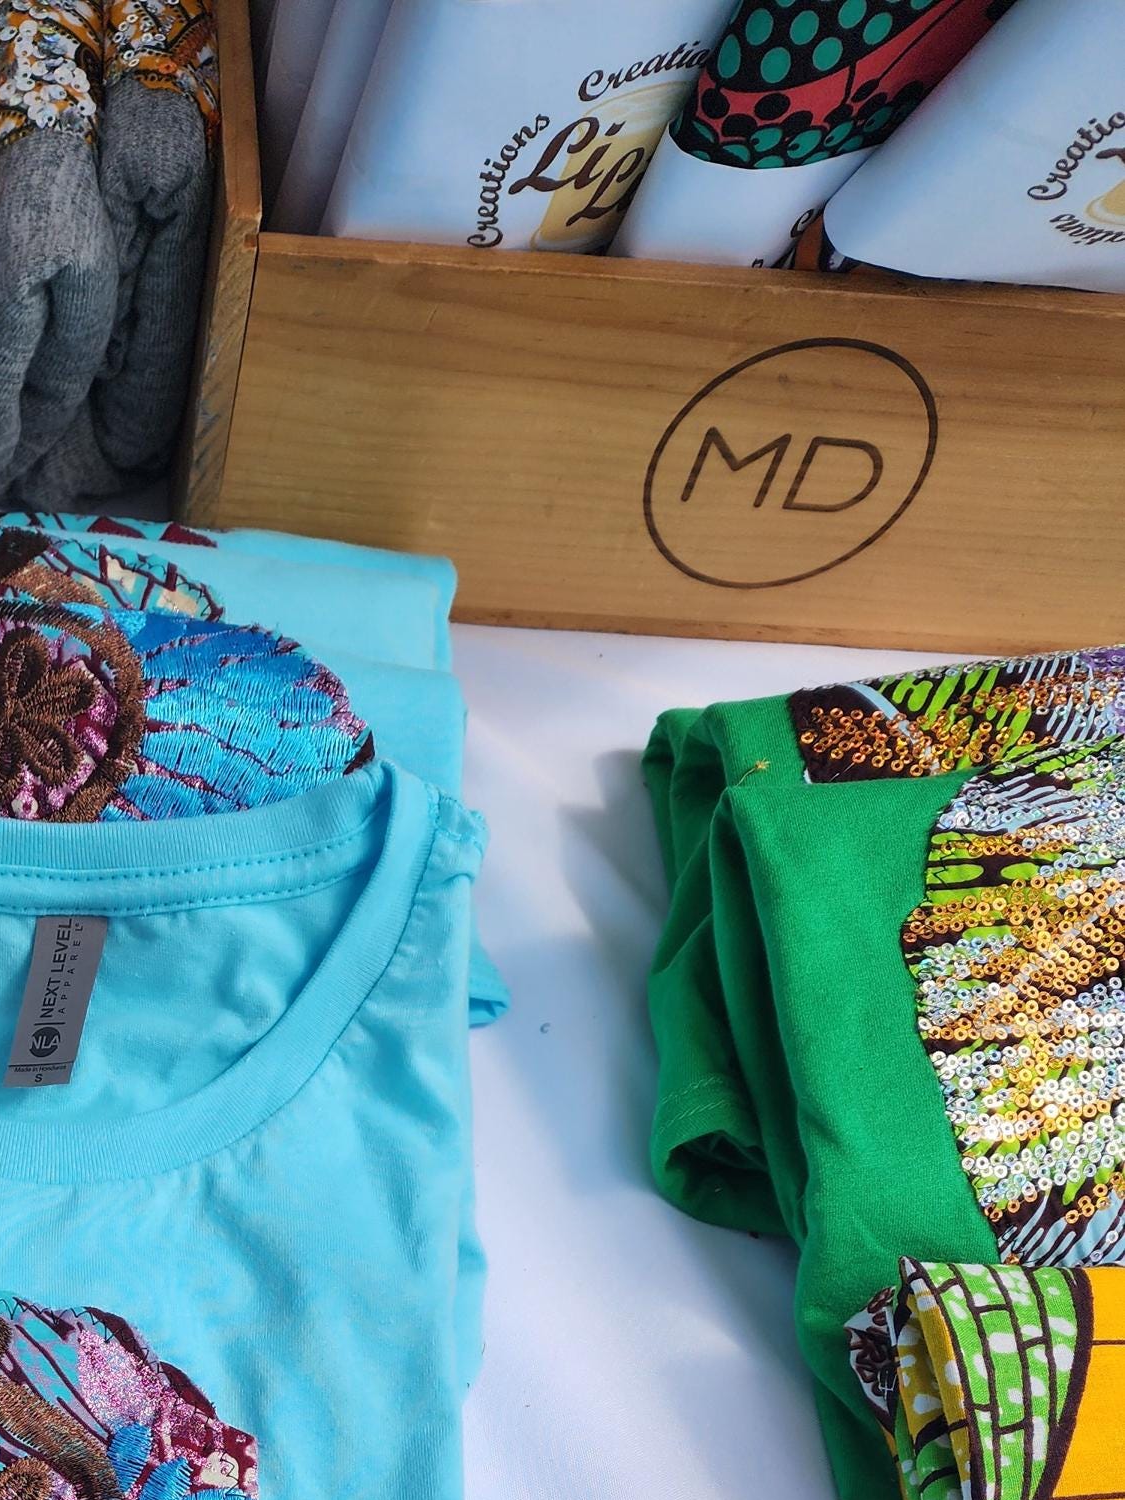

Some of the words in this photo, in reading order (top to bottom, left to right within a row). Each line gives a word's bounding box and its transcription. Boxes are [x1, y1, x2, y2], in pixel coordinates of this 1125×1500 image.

[467, 113, 550, 248] Creations
[508, 116, 625, 195] Li
[680, 425, 884, 512] MD
[40, 978, 62, 1019] NEXT
[51, 918, 73, 973] LEVEL
[30, 1034, 62, 1050] NLA
[34, 1073, 44, 1083] S
